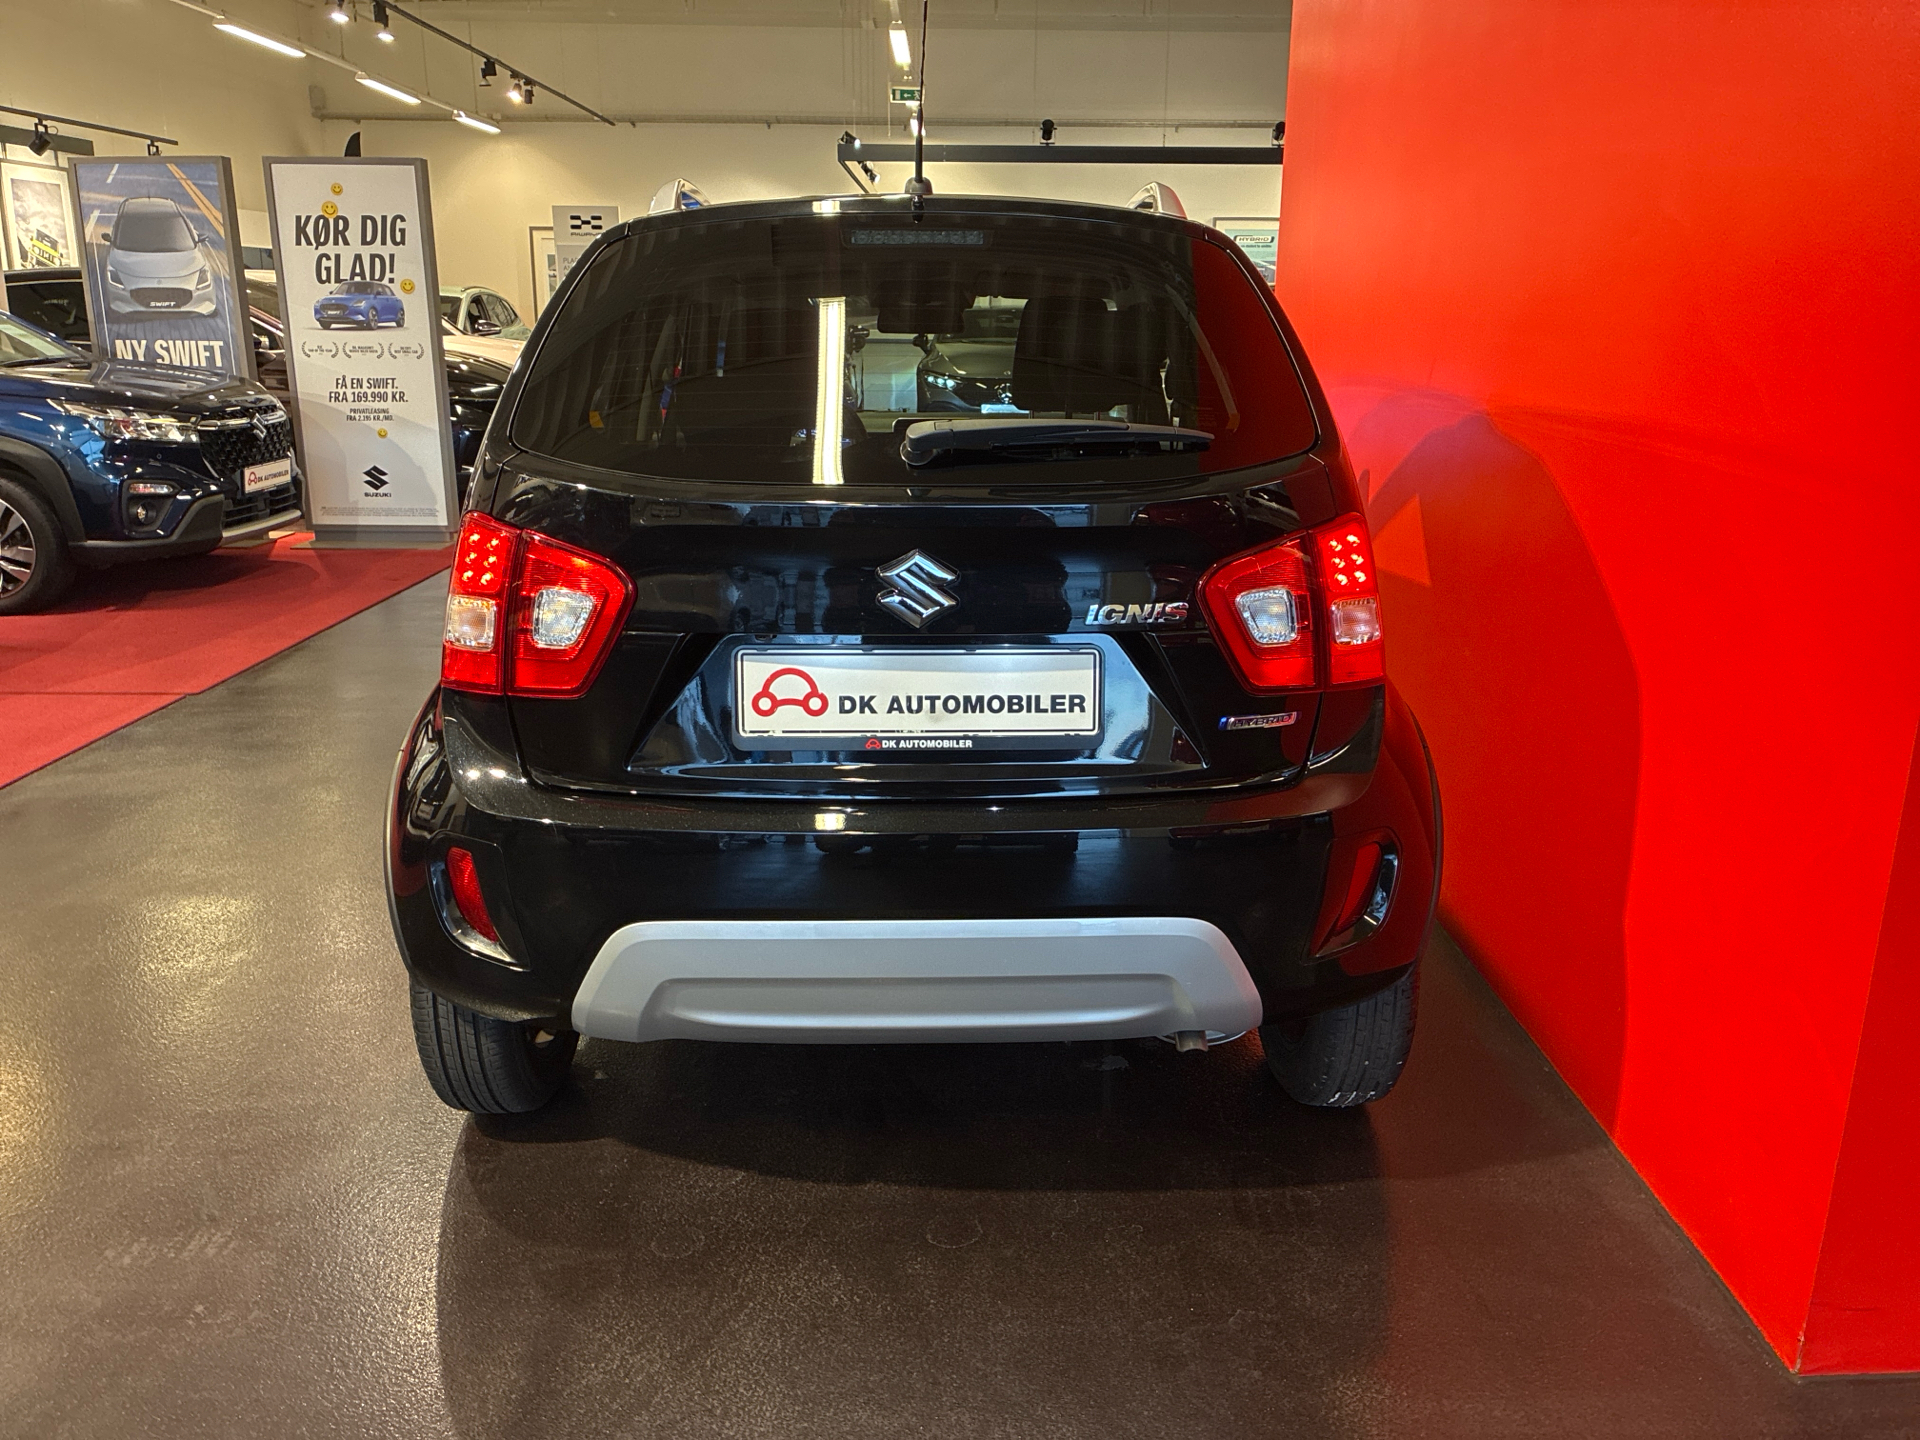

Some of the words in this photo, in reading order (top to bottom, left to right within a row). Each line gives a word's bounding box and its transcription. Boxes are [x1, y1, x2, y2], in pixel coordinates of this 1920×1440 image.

[295, 214, 350, 250] KØR
[361, 214, 407, 246] DIG
[315, 252, 395, 284] GLAD!
[115, 339, 147, 361] NY
[154, 339, 224, 367] SWIFT
[335, 374, 348, 389] FÅ
[350, 377, 364, 390] EN
[366, 377, 399, 390] SWIFT.
[328, 391, 348, 403] FRA
[351, 391, 388, 403] 169.990
[391, 391, 409, 403] KR.
[1085, 602, 1189, 625] IGNIS
[838, 695, 877, 715] DK
[886, 694, 1086, 715] AUTOMOBILER
[881, 740, 897, 748] DK
[898, 740, 973, 748] AUTOMOBILER
